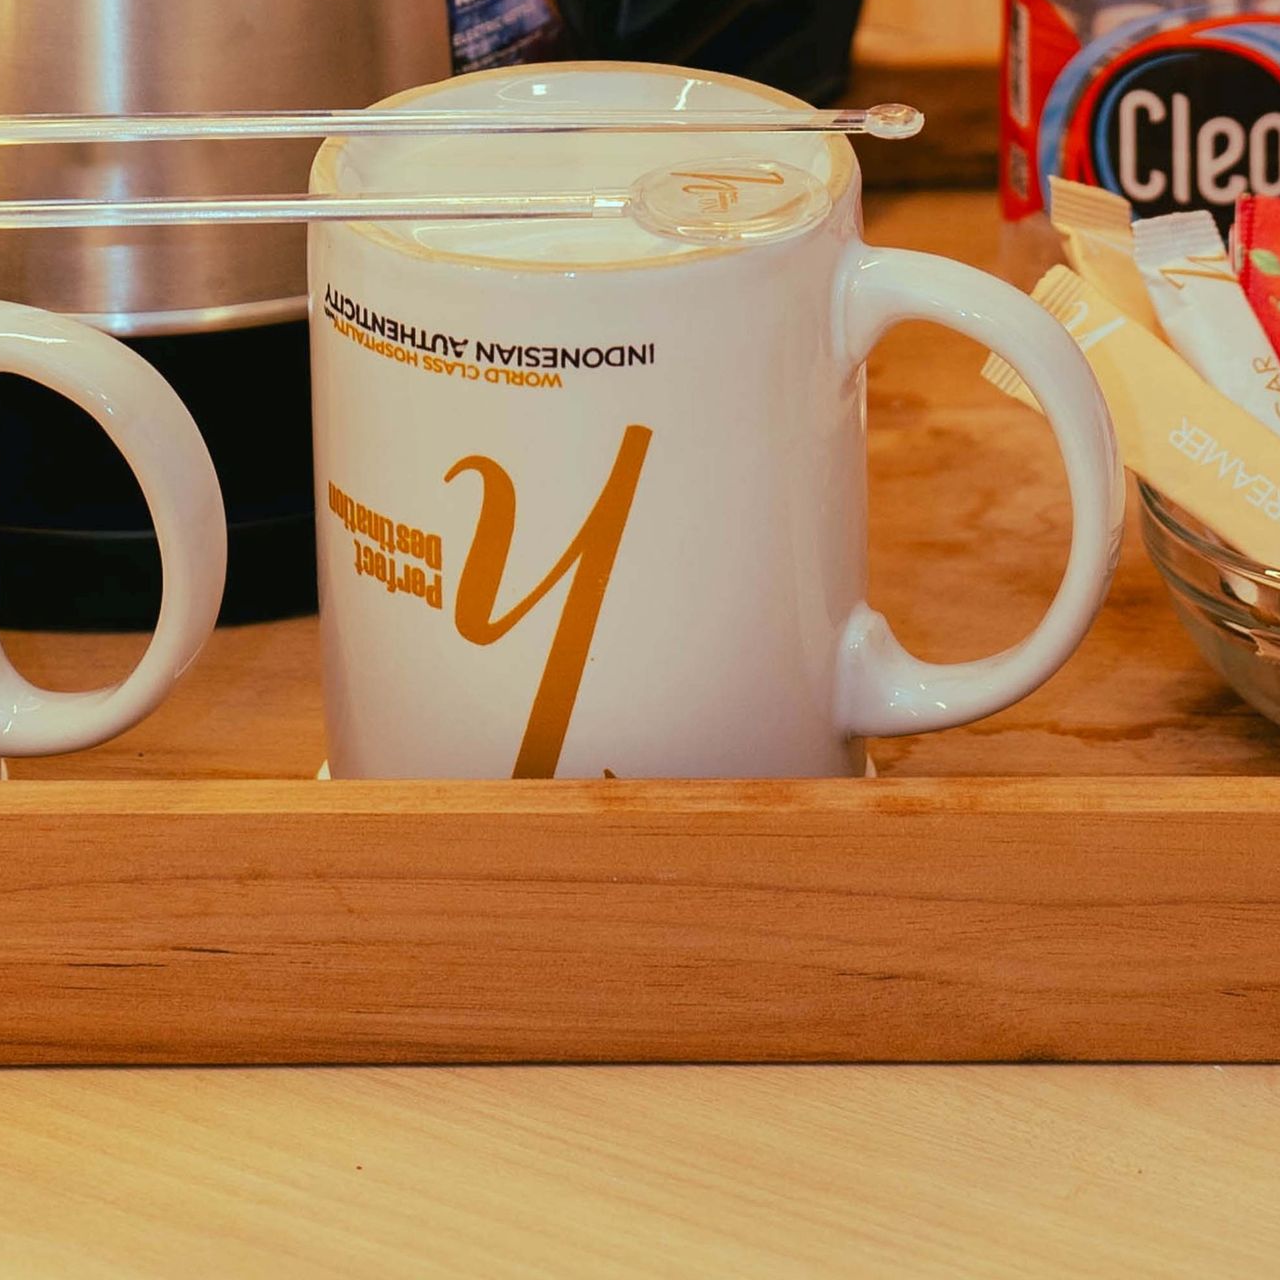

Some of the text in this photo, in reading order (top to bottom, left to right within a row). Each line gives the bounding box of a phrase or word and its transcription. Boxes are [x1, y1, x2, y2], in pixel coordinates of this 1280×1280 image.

[324, 283, 656, 369] INDONESIAN AUTHENTICITY
[332, 318, 563, 389] WORLD CLASS HOSPITALITY
[327, 479, 443, 572] Destination
[353, 538, 444, 611] Perfect
